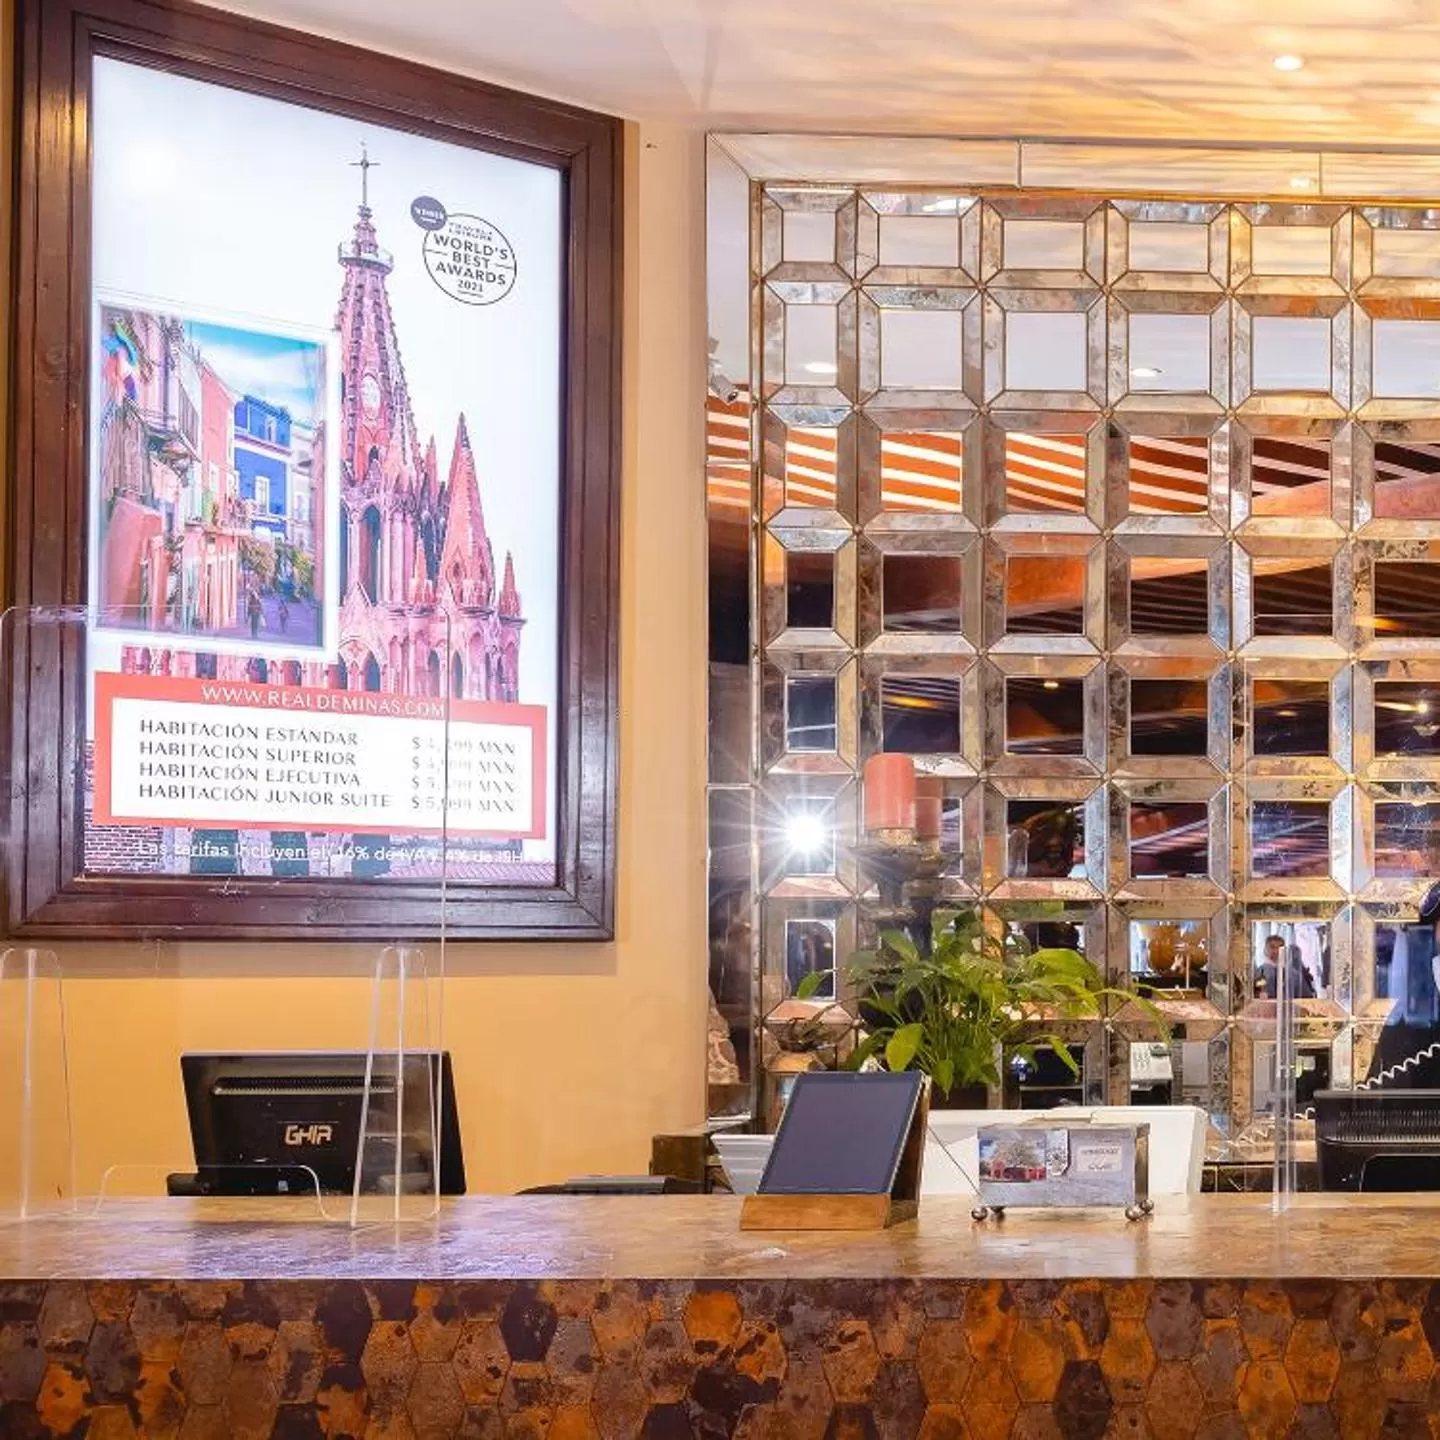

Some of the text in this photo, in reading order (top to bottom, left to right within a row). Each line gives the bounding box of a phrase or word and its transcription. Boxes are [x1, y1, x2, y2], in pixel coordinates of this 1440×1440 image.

[433, 233, 508, 260] WORLD'S
[452, 251, 490, 268] BEST
[435, 261, 506, 285] AWARDS
[202, 685, 444, 717] WWW.REALDEMINAS.COM
[139, 719, 259, 740] HABITACIÓN
[139, 741, 356, 766] HABITACIÓN SUPERIOR
[139, 763, 361, 787] HABITACIÓN EJECUTIVA
[139, 784, 392, 808] HABITACIÓN JUNIOR SUITE
[175, 840, 229, 857] tarifas
[285, 1124, 332, 1145] GHIA
